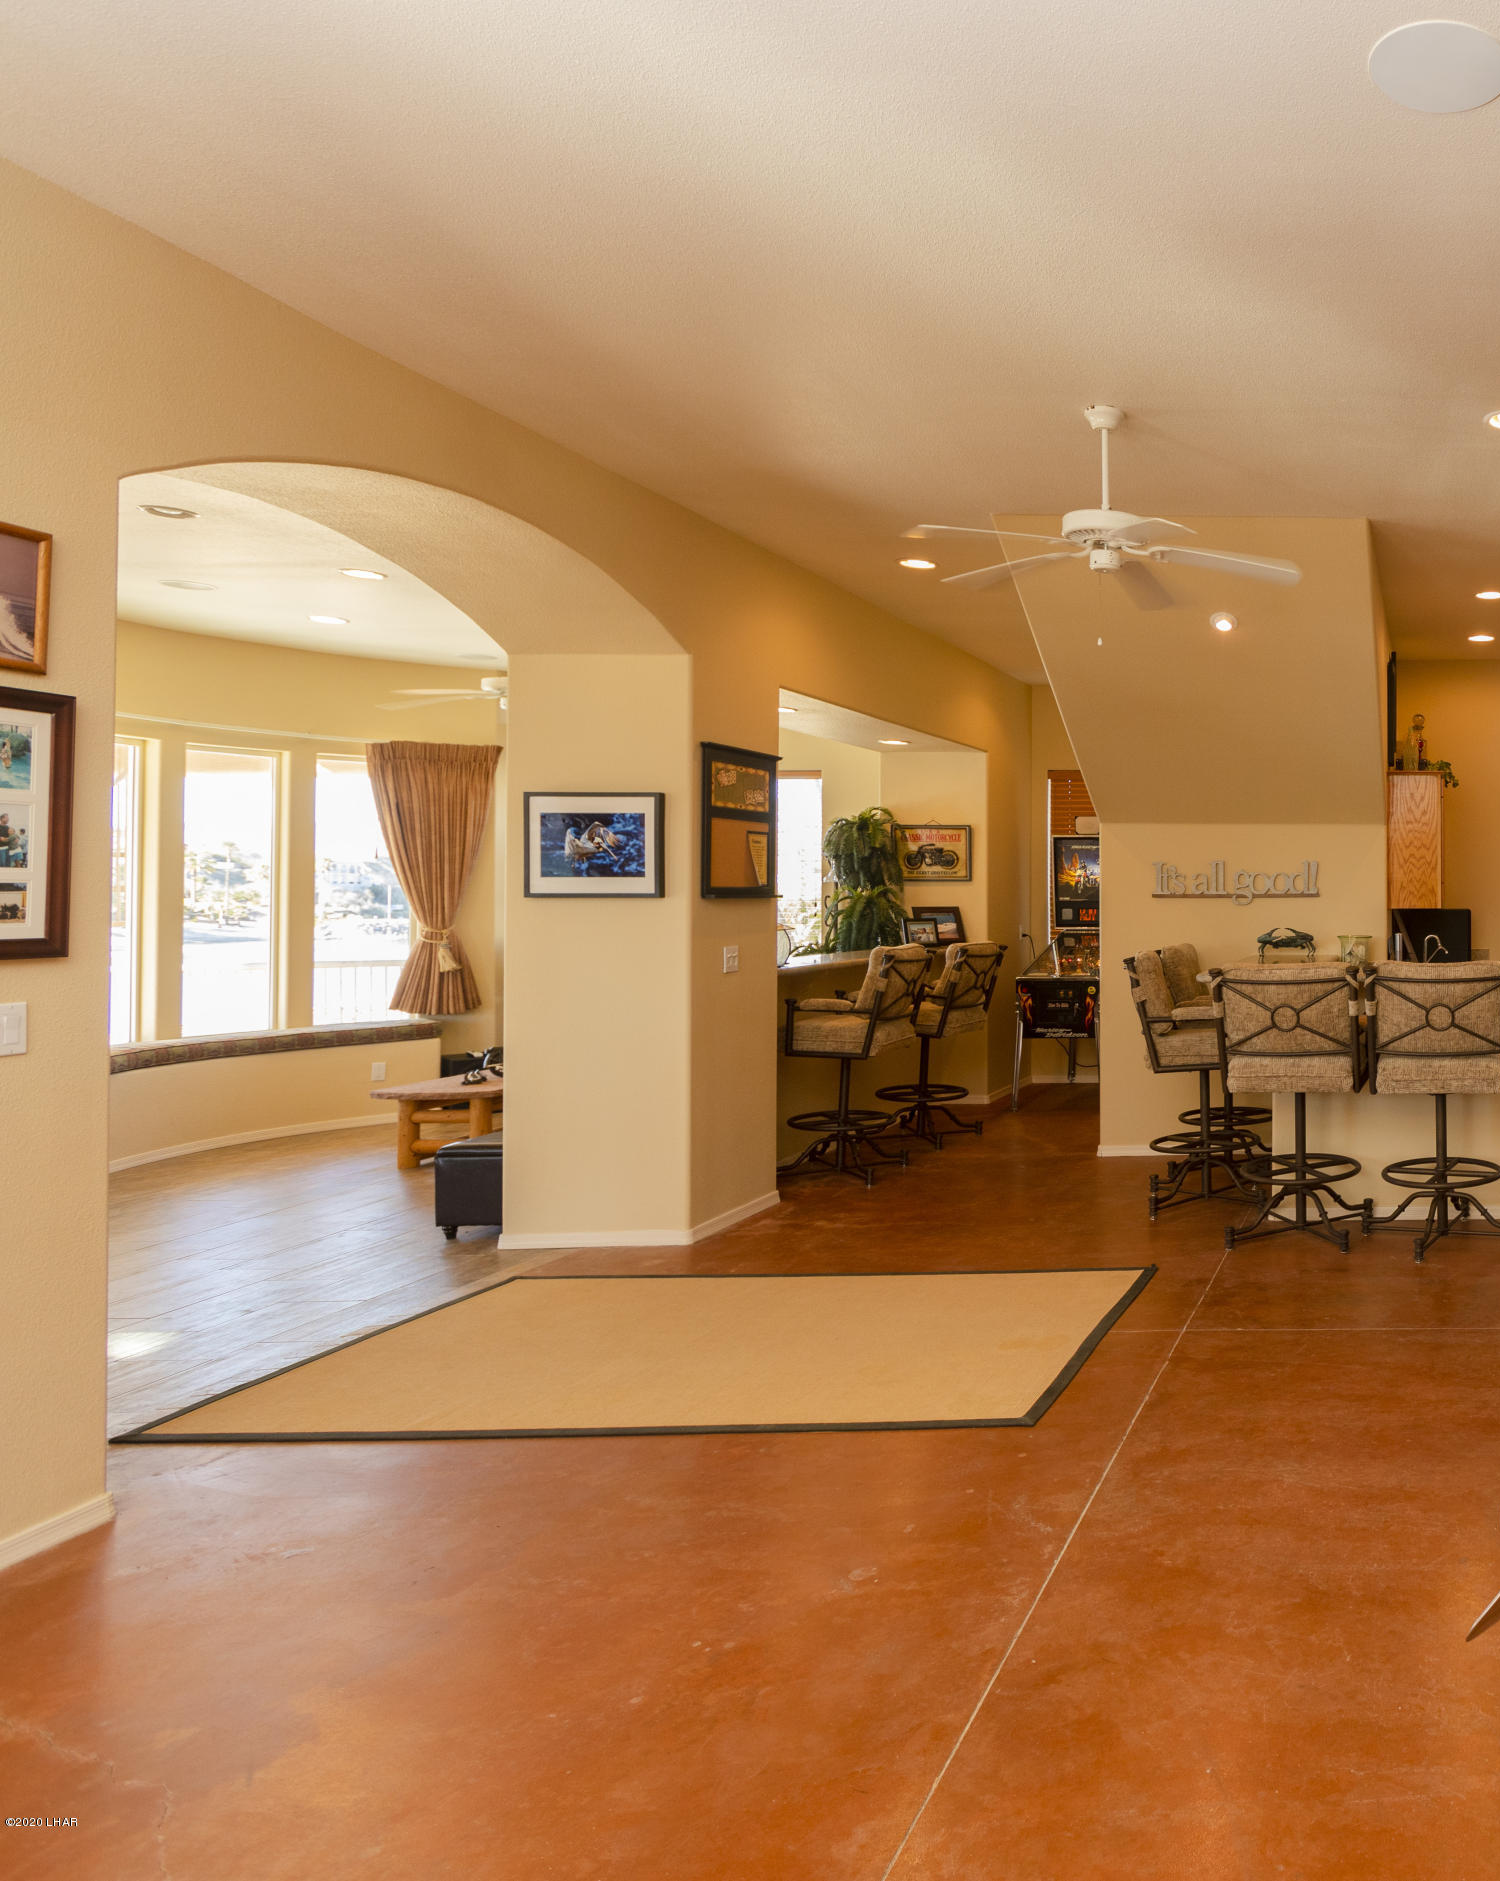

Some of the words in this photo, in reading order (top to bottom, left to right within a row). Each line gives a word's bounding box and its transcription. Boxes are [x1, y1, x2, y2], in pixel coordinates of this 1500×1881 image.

[1152, 861, 1186, 895] It's
[1191, 860, 1228, 895] all
[1232, 860, 1319, 905] good!
